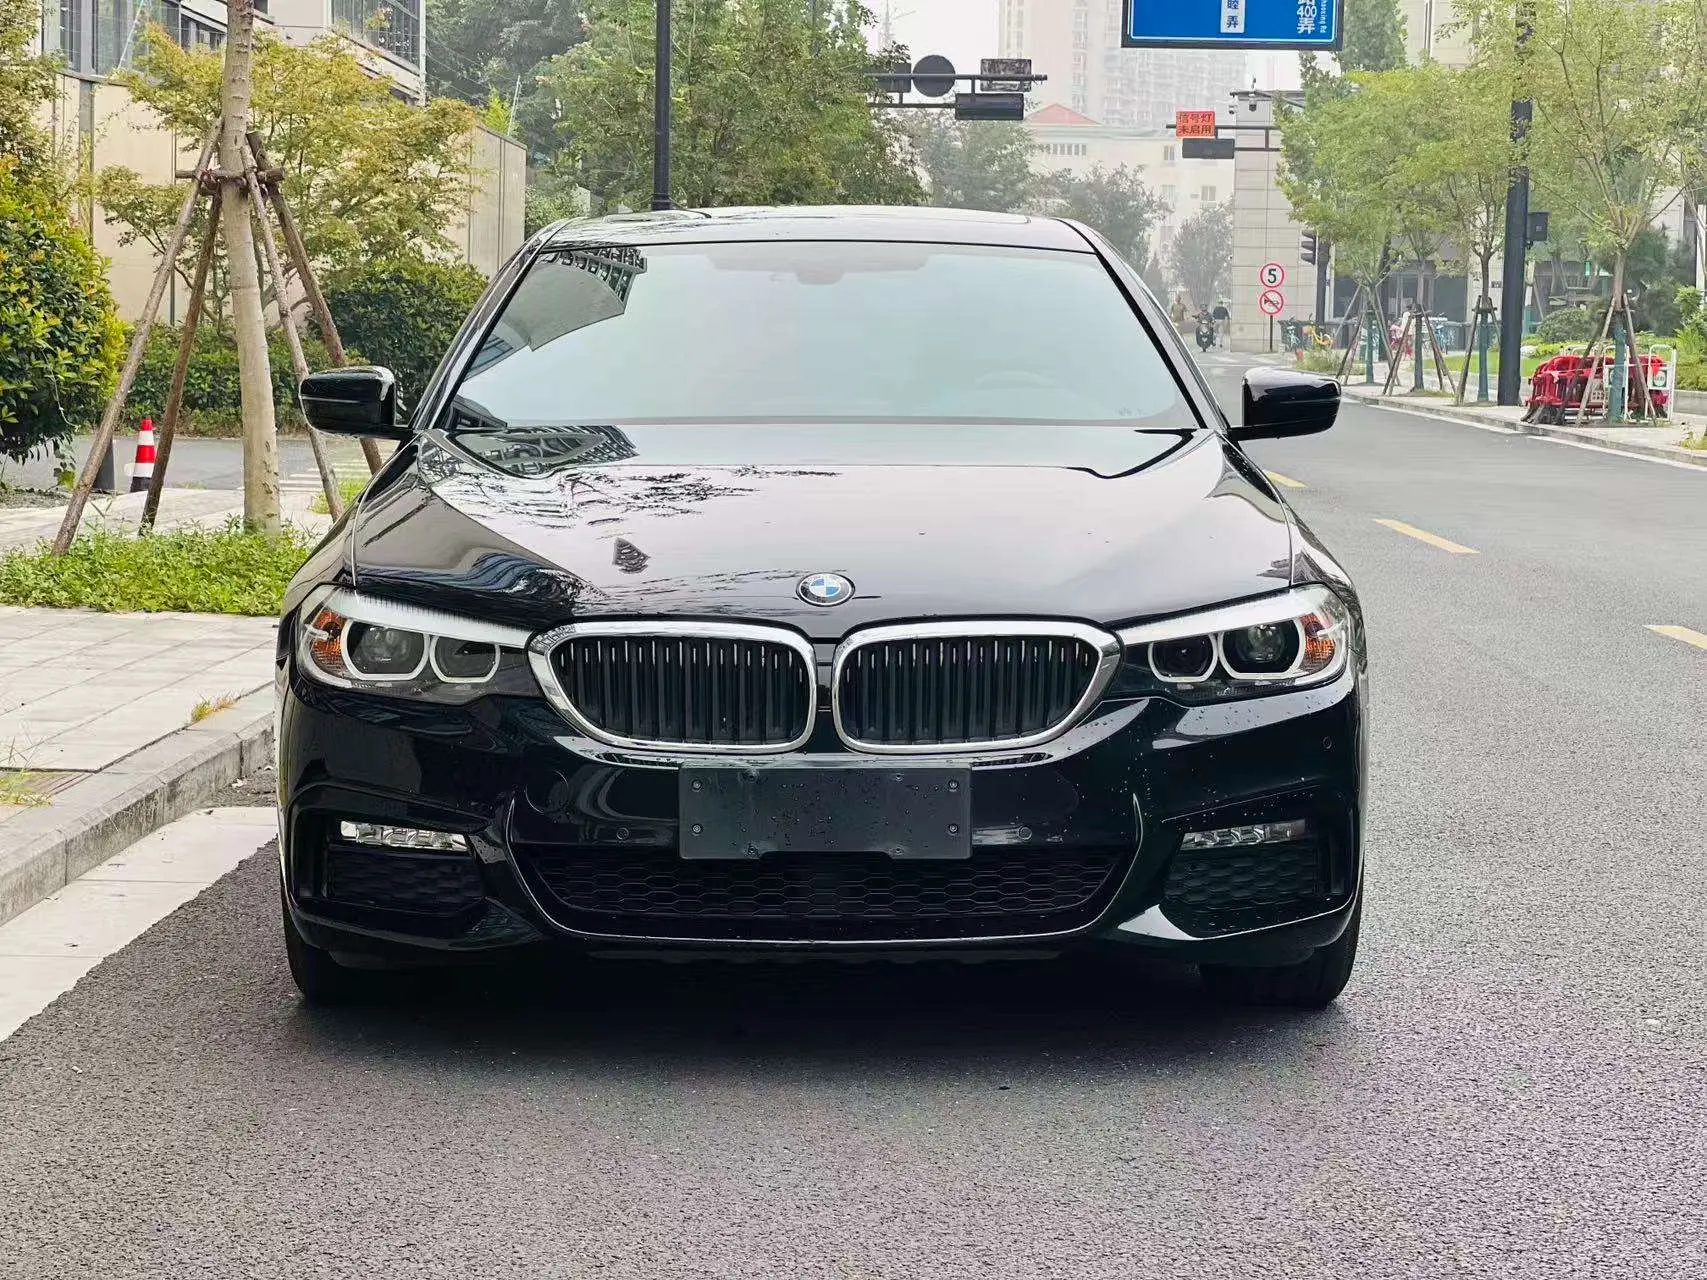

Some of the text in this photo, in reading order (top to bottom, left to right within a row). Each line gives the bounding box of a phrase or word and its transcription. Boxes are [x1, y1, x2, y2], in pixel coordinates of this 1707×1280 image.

[1176, 112, 1213, 124] 信号灯
[1176, 124, 1212, 135] 未启用
[1267, 268, 1277, 284] 5
